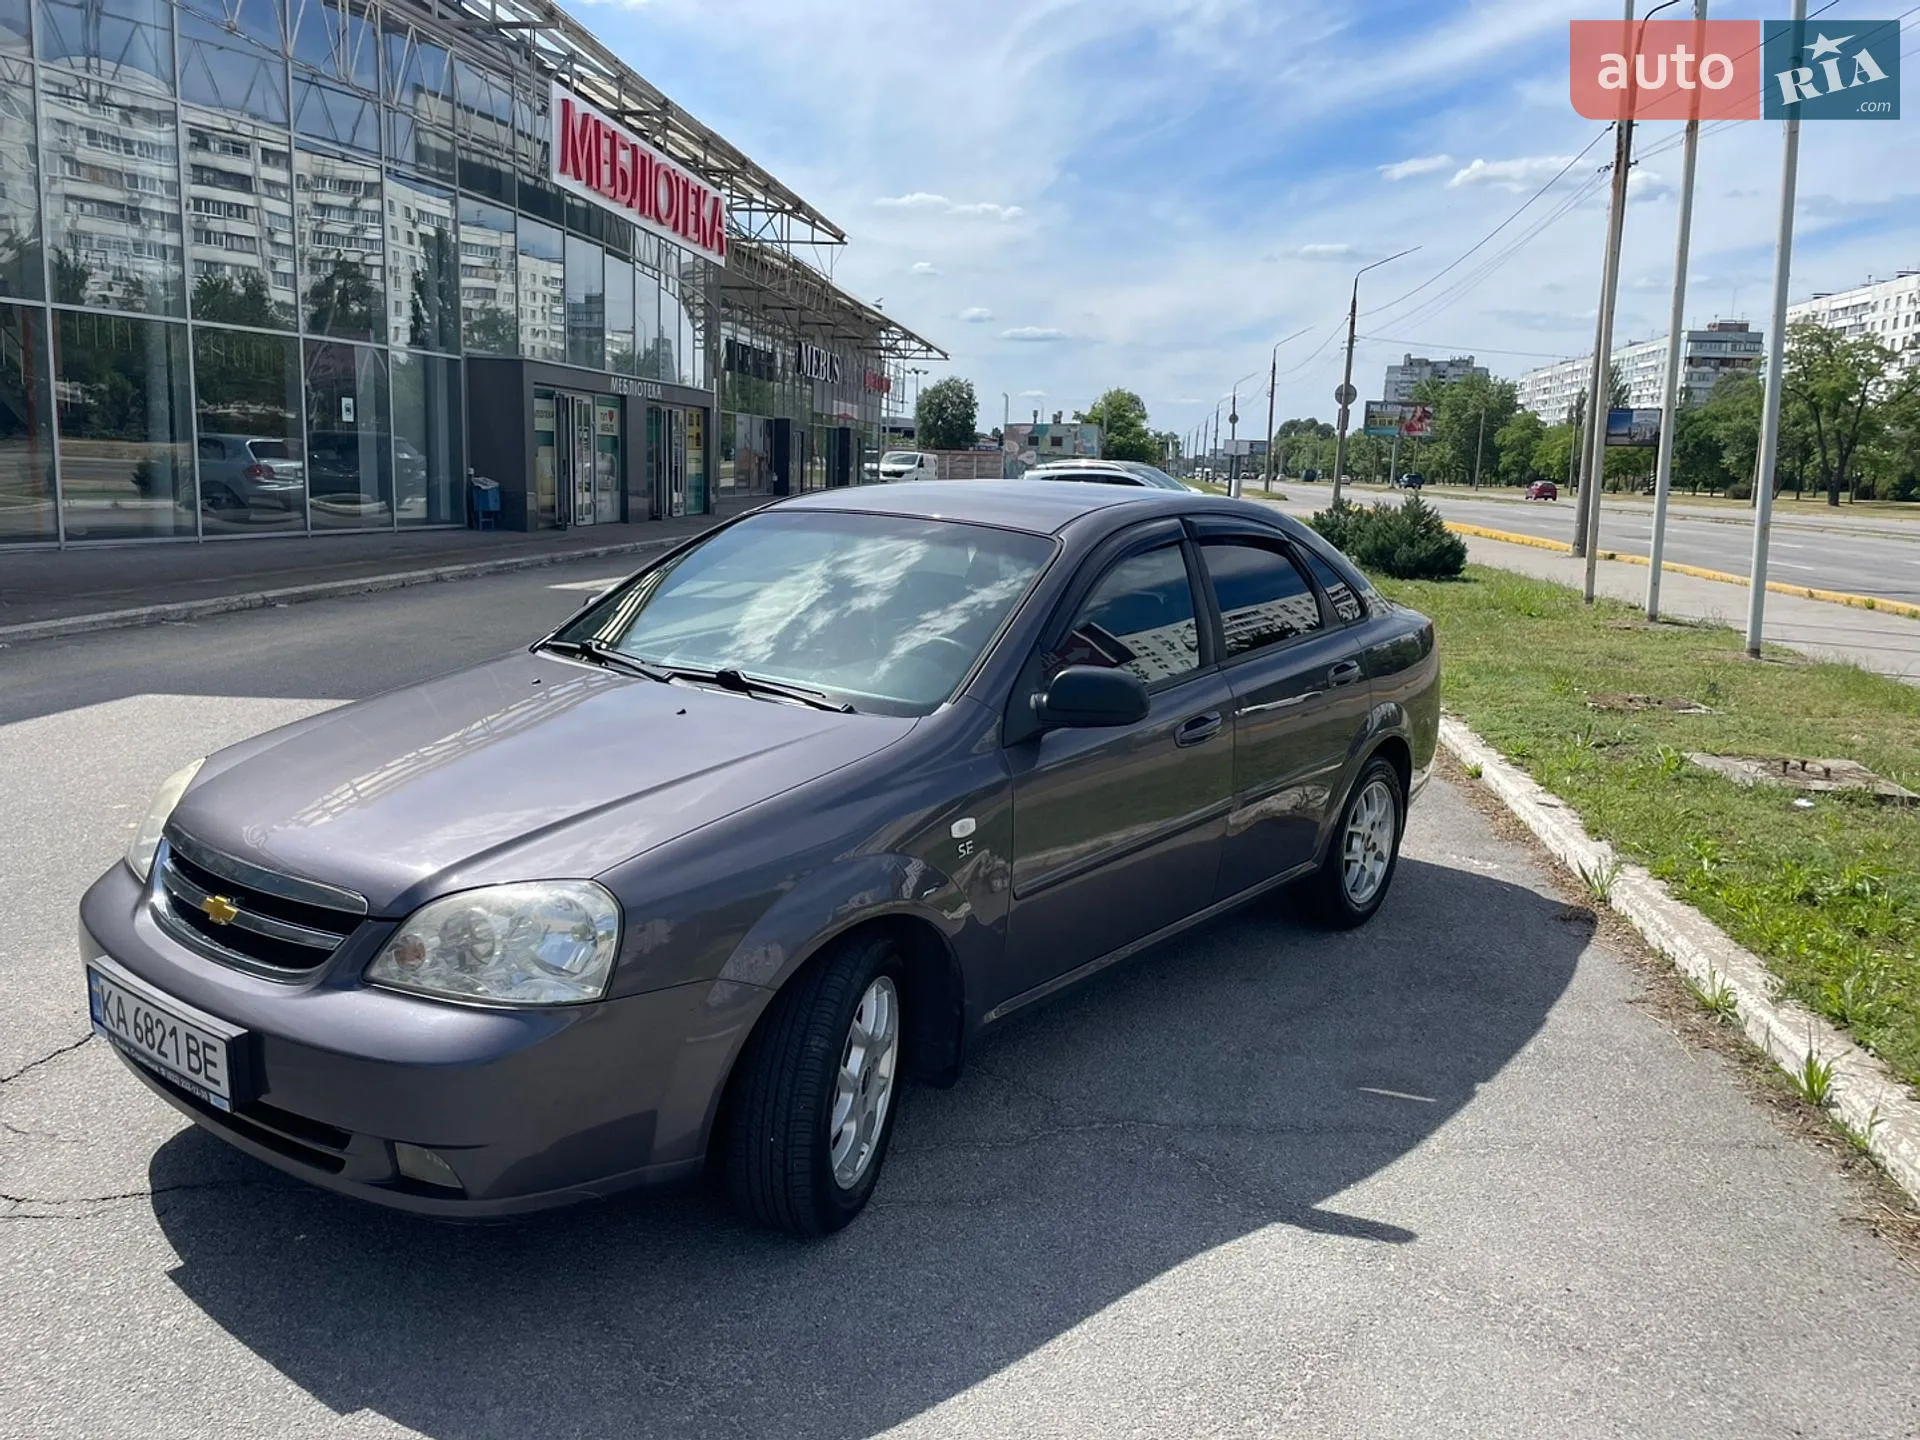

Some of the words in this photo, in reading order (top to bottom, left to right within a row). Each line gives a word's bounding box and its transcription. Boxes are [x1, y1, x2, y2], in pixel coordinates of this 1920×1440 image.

[559, 98, 727, 257] МЕБЛІОТЕКА
[609, 376, 663, 400] МЕБЛІОТЕКА
[958, 840, 974, 859] SE
[100, 985, 130, 1036] KA
[133, 1006, 180, 1066] 6821
[185, 1031, 222, 1087] BE
